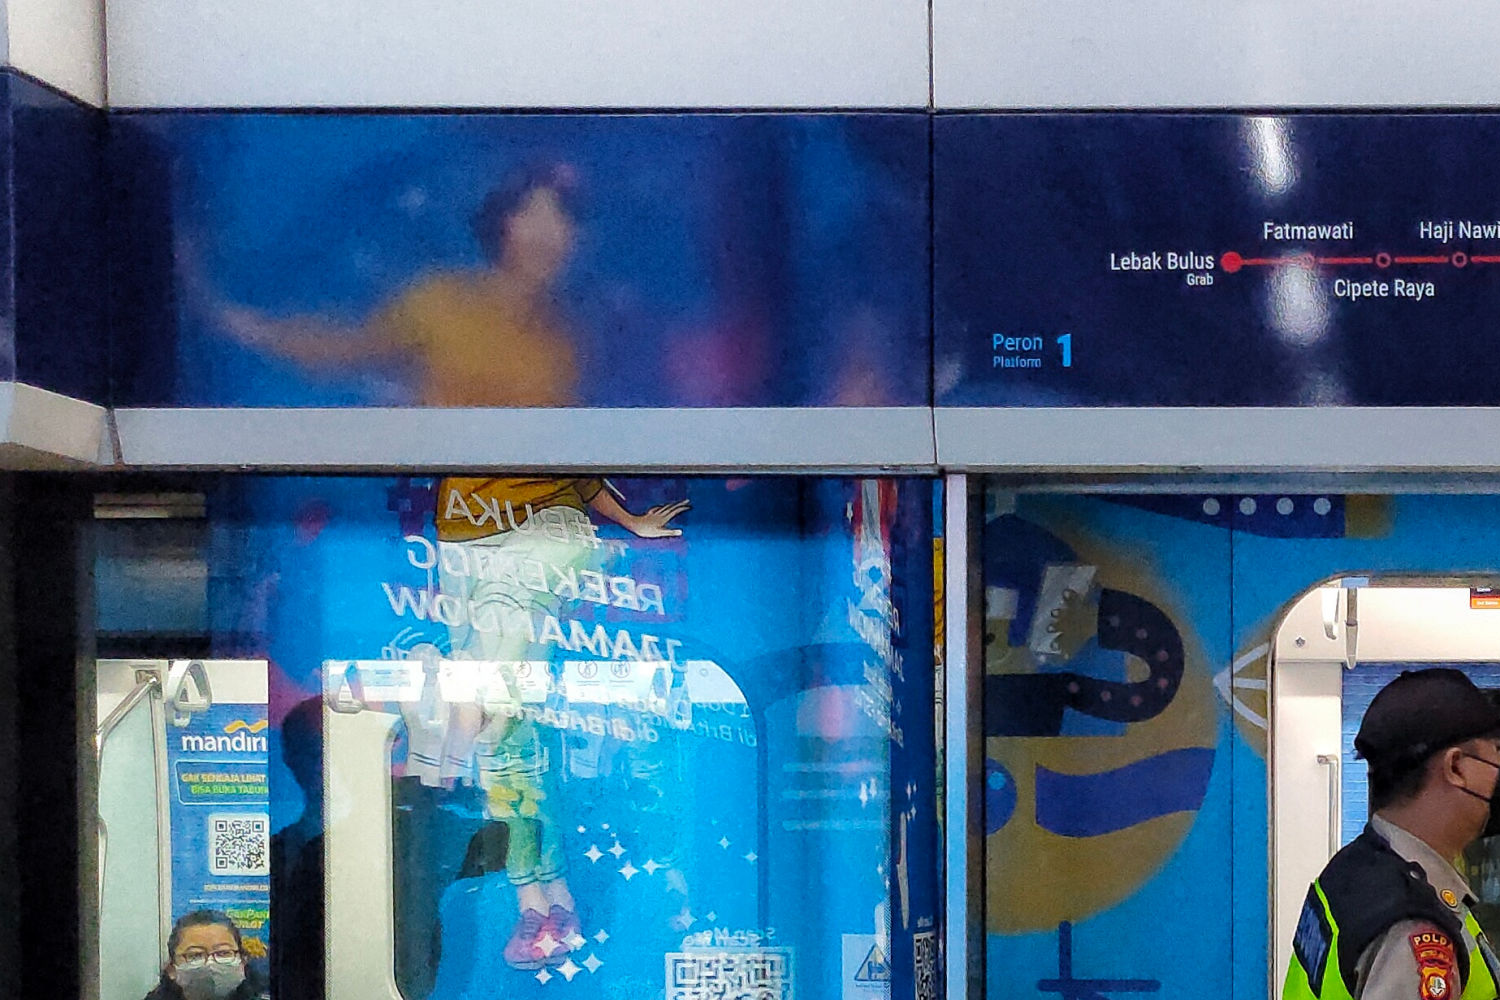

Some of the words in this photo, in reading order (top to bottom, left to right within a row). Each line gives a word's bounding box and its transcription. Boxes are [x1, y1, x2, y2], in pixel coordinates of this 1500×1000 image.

[1263, 221, 1354, 241] Fatmawati
[1419, 221, 1455, 243] Haji
[1110, 252, 1161, 271] Lebak
[1167, 252, 1215, 271] Bulus
[1186, 273, 1214, 287] Grab
[1334, 279, 1388, 301] Cipete
[1394, 278, 1436, 300] Raya
[993, 333, 1043, 352] Peron
[1057, 333, 1072, 368] 1
[993, 355, 1042, 369] Platform
[181, 731, 268, 752] mandiri
[1413, 933, 1448, 946] POLD
